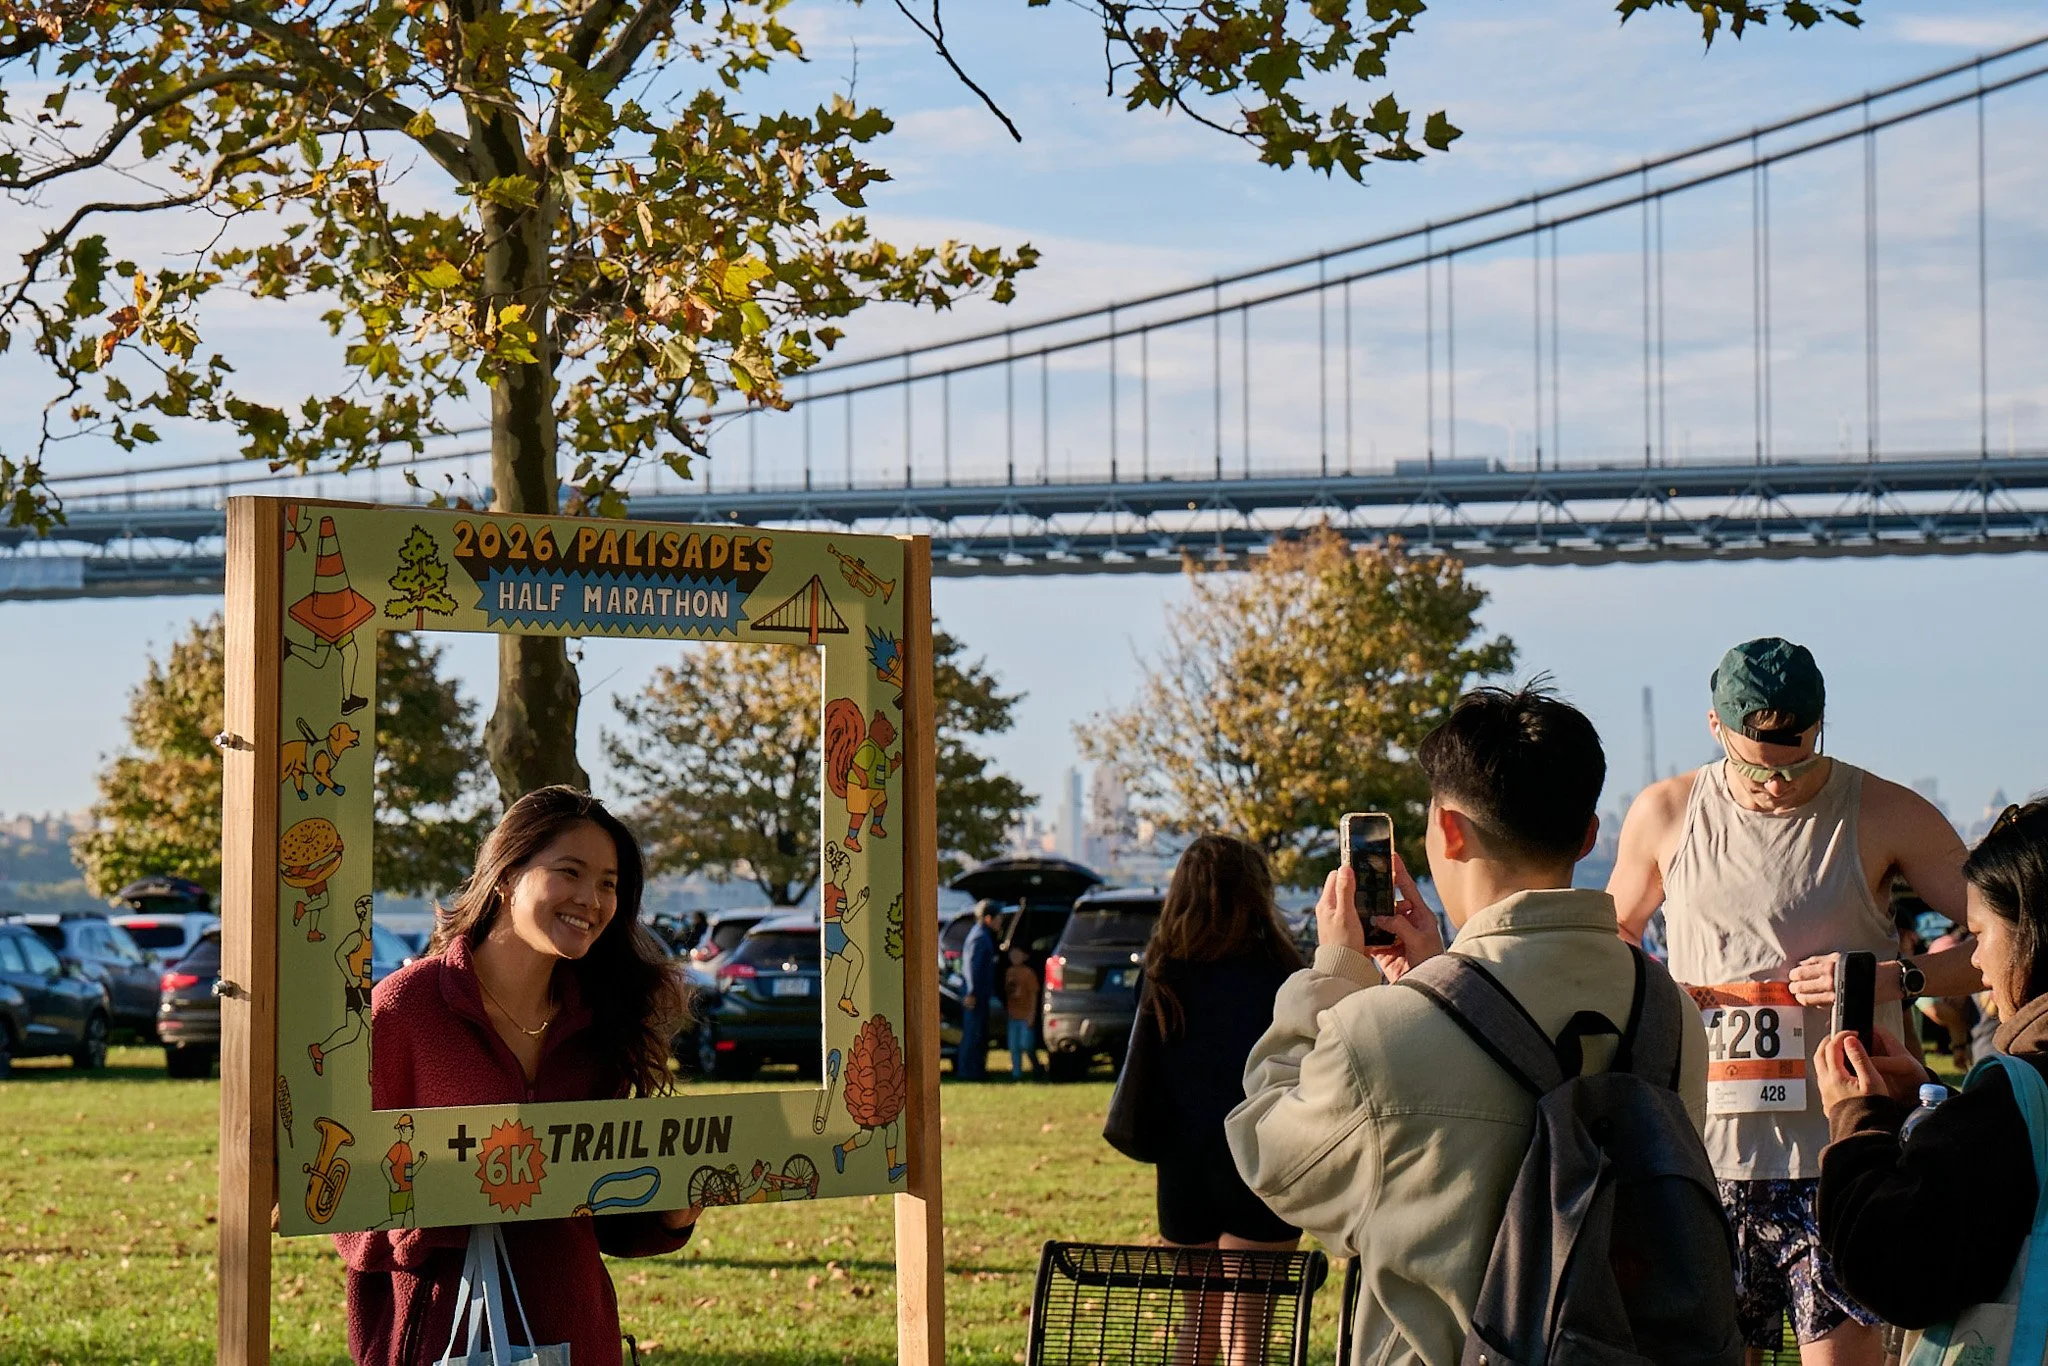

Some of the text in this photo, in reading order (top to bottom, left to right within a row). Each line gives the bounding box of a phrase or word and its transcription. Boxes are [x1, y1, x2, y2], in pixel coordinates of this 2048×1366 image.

[453, 520, 774, 573] 2026 PALISADES
[498, 581, 728, 619] HALF MARATHON
[1760, 1085, 1787, 1103] 428
[484, 1143, 536, 1187] 6K
[547, 1120, 649, 1164] TRAIL
[657, 1115, 733, 1158] RUN
